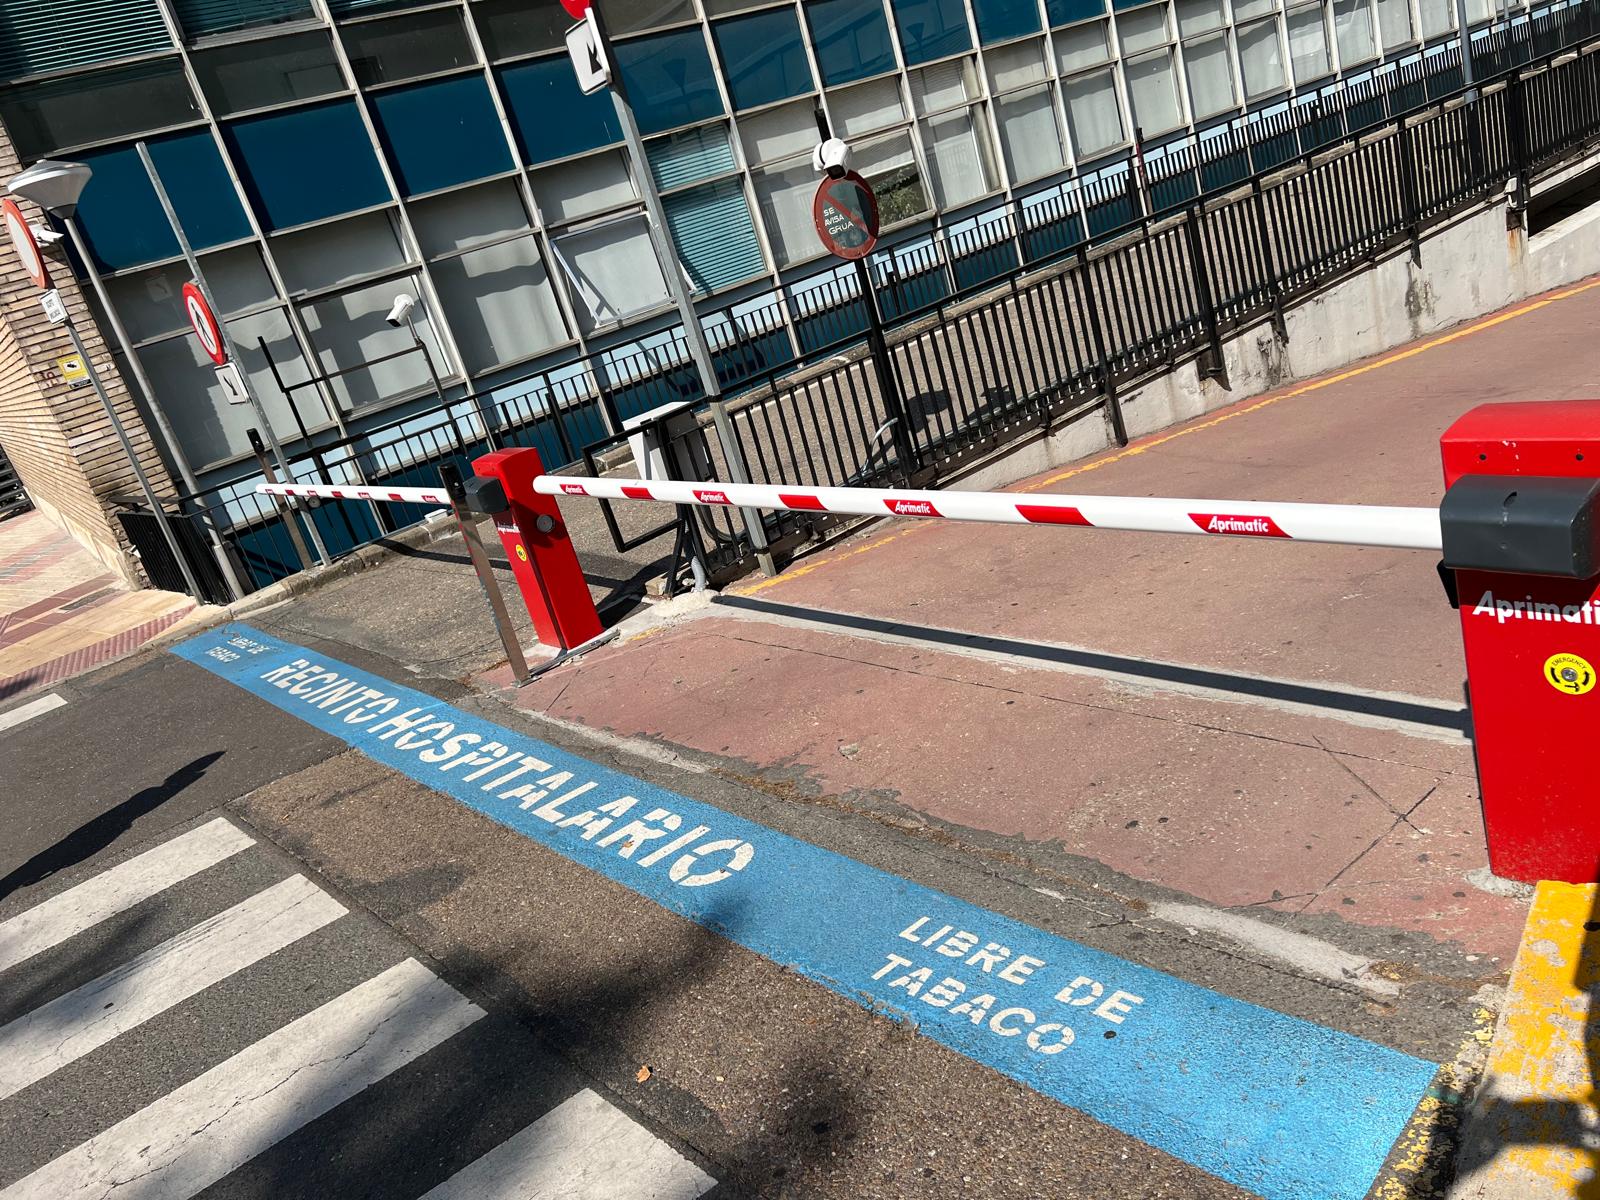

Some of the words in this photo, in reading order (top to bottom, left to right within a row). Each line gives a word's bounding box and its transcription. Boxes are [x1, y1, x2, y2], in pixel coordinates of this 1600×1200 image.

[823, 207, 835, 216] SE
[824, 214, 844, 226] AVISA
[828, 221, 854, 234] GRUA
[894, 500, 931, 515] Aprimatic
[1208, 515, 1269, 534] Aprimatic
[1551, 657, 1587, 669] EMERGENCY
[260, 658, 401, 725] RECINTO
[366, 706, 756, 887] HOSPITALARIO
[898, 916, 1046, 985] LIBRE
[1054, 976, 1145, 1024] DE
[871, 953, 1076, 1055] TABACO
